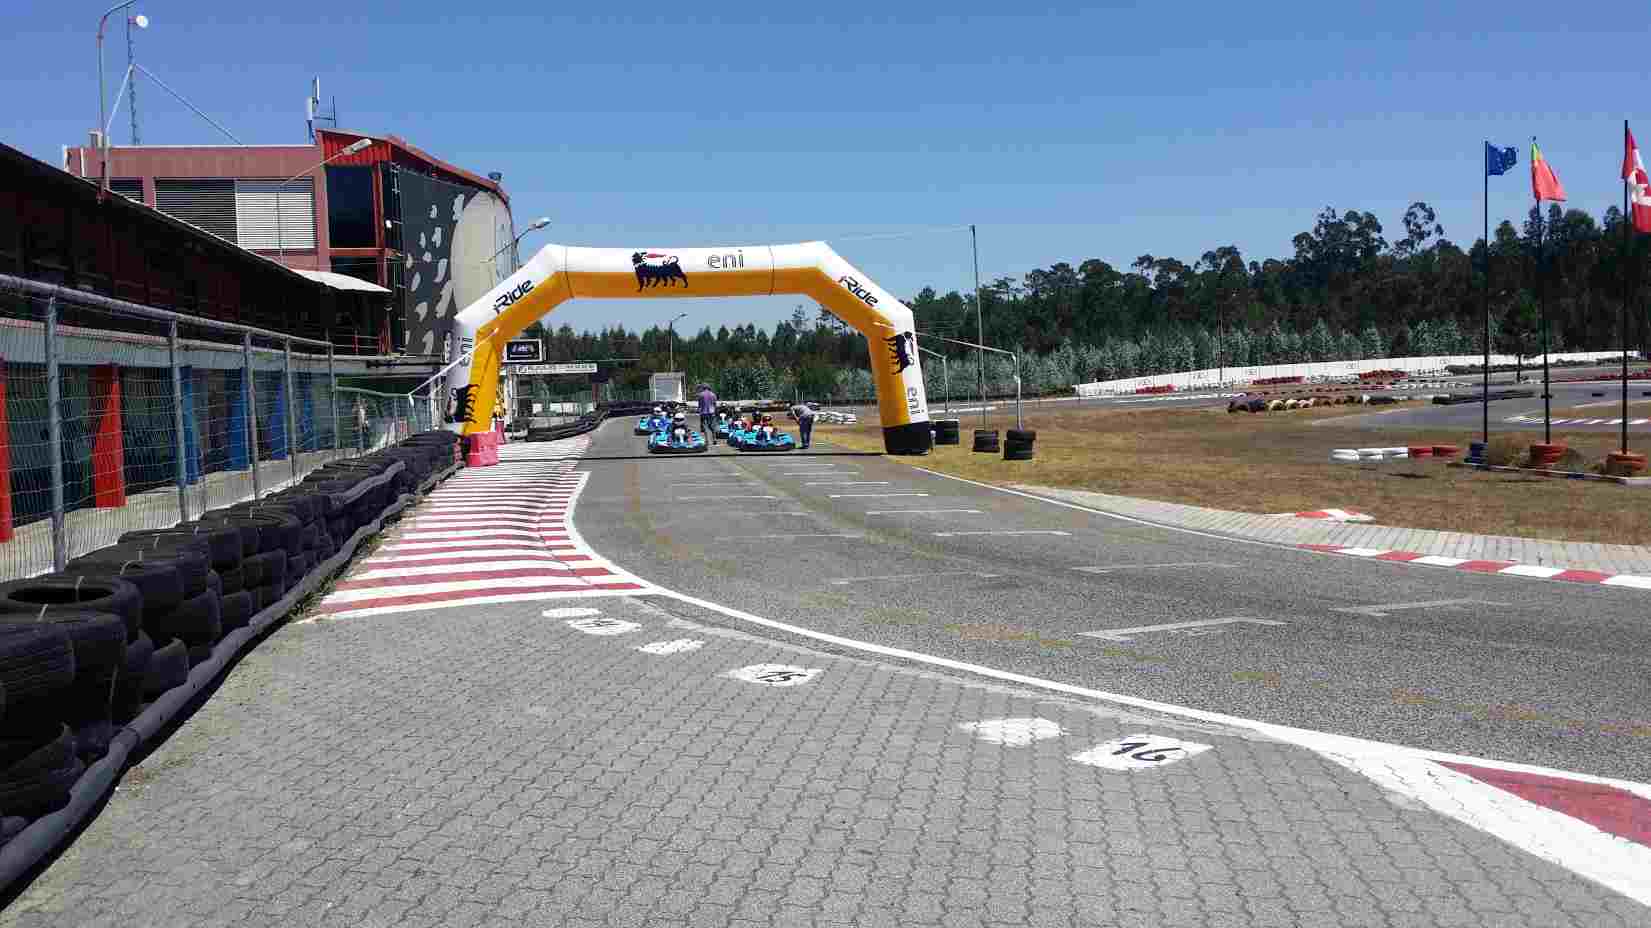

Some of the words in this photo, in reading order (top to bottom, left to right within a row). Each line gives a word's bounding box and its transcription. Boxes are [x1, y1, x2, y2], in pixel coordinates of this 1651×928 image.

[707, 249, 744, 271] eni
[907, 386, 924, 414] eni
[1112, 741, 1183, 761] 16
